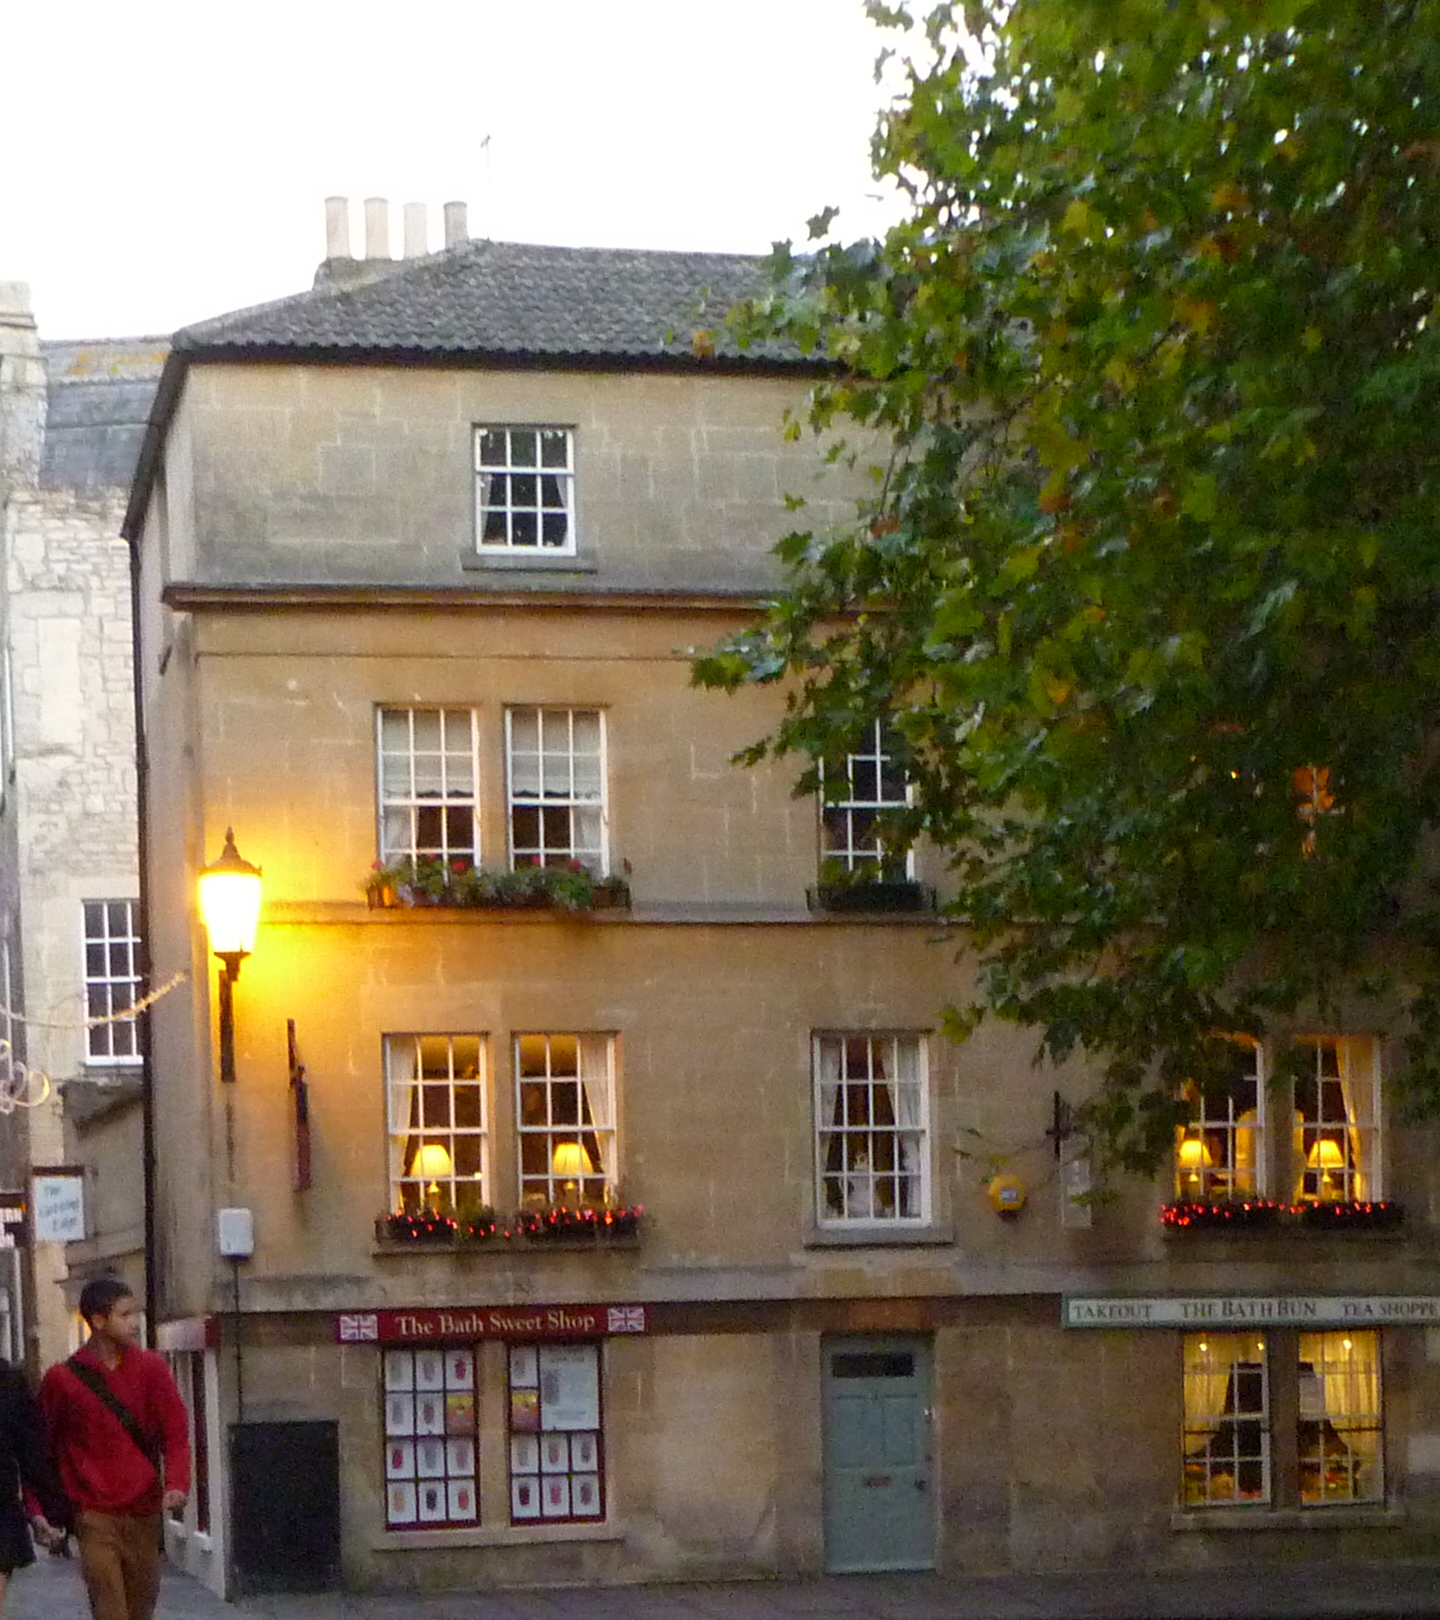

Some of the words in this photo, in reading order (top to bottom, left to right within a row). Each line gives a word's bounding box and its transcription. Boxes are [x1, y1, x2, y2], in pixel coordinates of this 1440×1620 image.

[1072, 1304, 1152, 1319] TAKEOUT
[1180, 1302, 1217, 1318] THE
[1221, 1300, 1272, 1318] BATH
[1276, 1300, 1316, 1317] BUN
[1342, 1303, 1373, 1316] TEA
[1379, 1302, 1437, 1316] SHOPPE
[395, 1315, 434, 1336] The
[439, 1313, 484, 1334] Bath
[489, 1312, 543, 1333] Sweet
[547, 1310, 596, 1331] Shop
